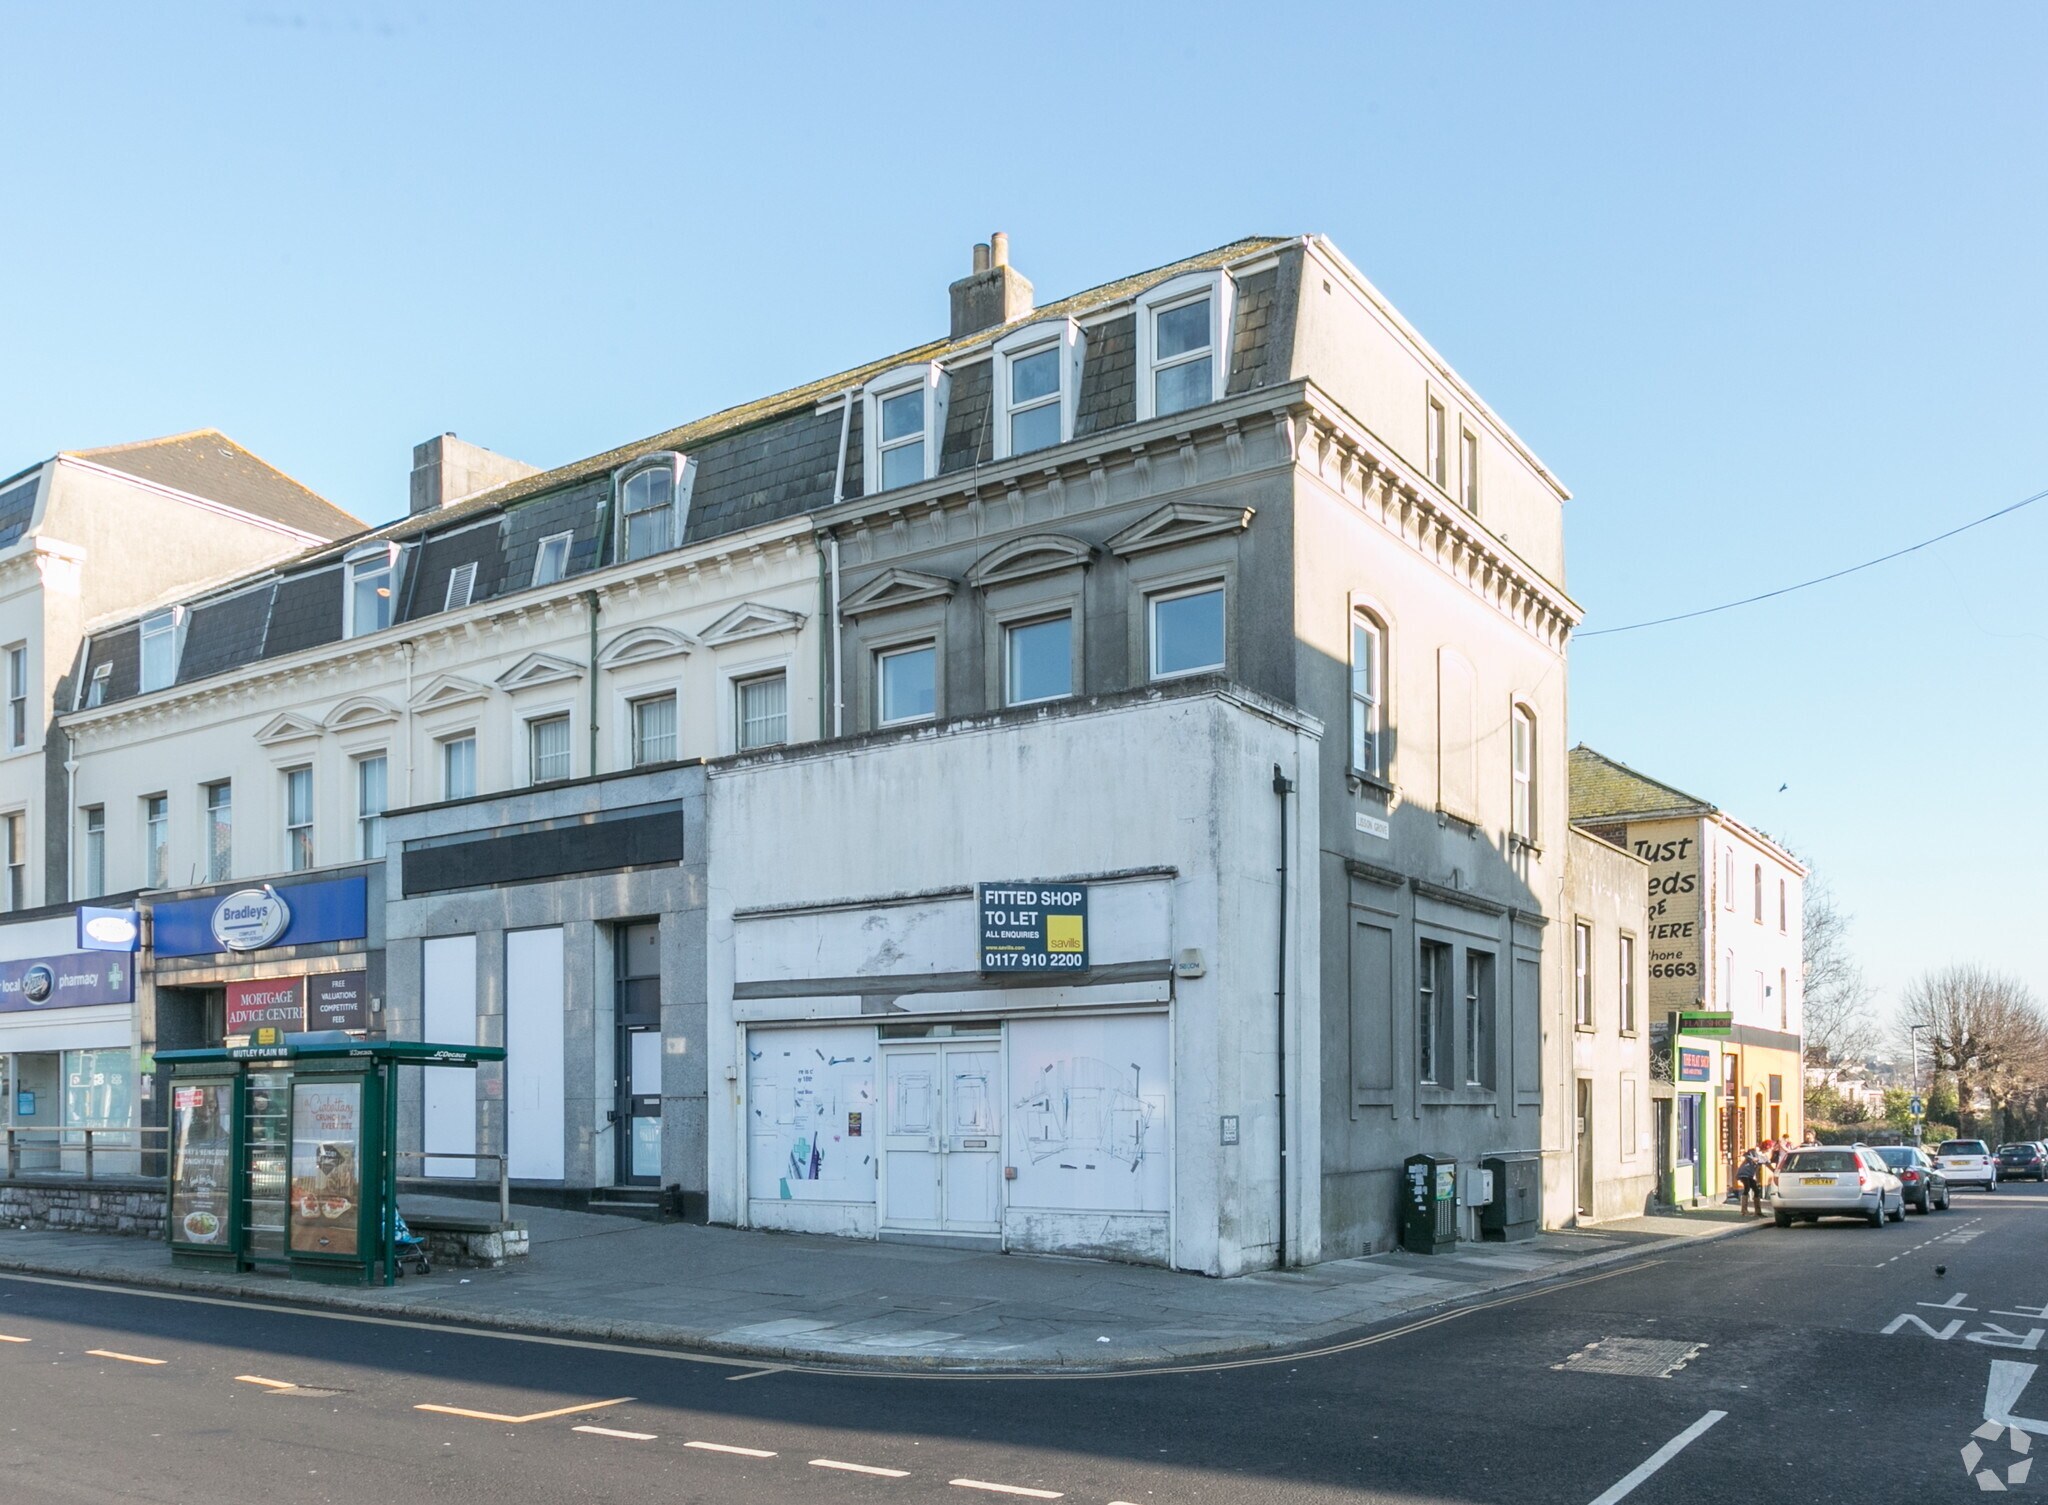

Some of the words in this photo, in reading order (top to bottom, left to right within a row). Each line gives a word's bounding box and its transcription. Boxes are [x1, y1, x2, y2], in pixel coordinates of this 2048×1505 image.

[1648, 871, 1696, 897] eds
[985, 890, 1037, 905] FITTED
[1041, 891, 1082, 906] SHOP
[223, 905, 268, 921] Bradleys
[985, 911, 1006, 925] TO
[1010, 911, 1038, 926] LET
[1001, 931, 1040, 939] ENQUIRIES
[1050, 938, 1081, 948] savills
[985, 953, 1018, 966] 0117
[1021, 953, 1047, 966] 910
[1050, 953, 1082, 966] 2200
[1648, 950, 1683, 961] hone
[1648, 962, 1697, 978] 6663
[2, 980, 20, 993] local
[59, 973, 99, 990] pharmacy
[332, 980, 346, 988] FREE
[241, 990, 293, 1006] MORTGAGE
[321, 991, 357, 1000] VALUATIONS
[320, 1003, 358, 1012] COMPETITIVE
[229, 1008, 264, 1023] ADVICE
[266, 1007, 304, 1021] CENTRE
[332, 1015, 345, 1023] FEES
[233, 1048, 257, 1057] MUTLEY
[258, 1048, 277, 1056] PLAIN
[434, 1050, 467, 1058] JCDecaux
